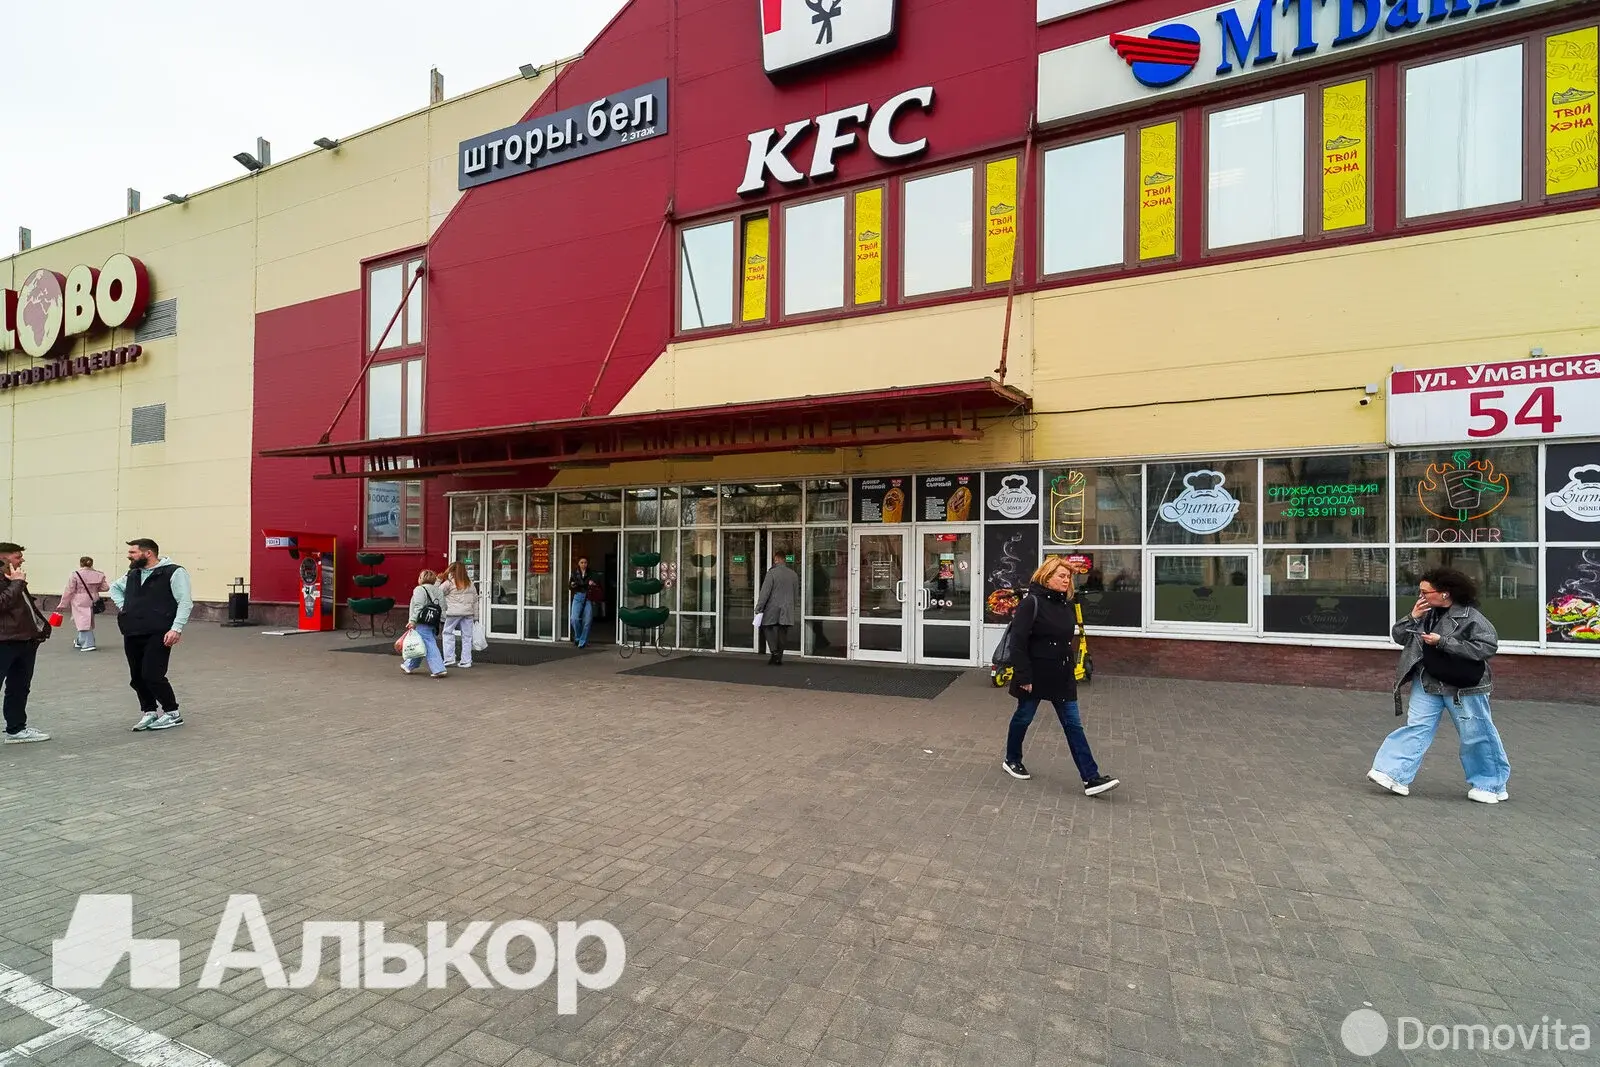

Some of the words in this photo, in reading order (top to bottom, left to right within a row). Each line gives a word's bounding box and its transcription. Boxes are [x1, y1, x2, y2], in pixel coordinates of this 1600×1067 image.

[1553, 102, 1591, 119] ТВОЙ
[1550, 117, 1594, 133] ХЭНД
[464, 94, 653, 174] шторы.бел
[621, 132, 628, 142] 2
[629, 125, 656, 140] этаж
[736, 86, 934, 195] KFC
[1326, 150, 1358, 164] ТВОЙ
[1324, 162, 1360, 175] ХЭНД
[1145, 184, 1171, 197] ТВОЙ
[1143, 197, 1172, 208] ХЭНД
[990, 215, 1013, 226] ТВОЙ
[74, 344, 141, 374] ЦЕНТР
[1415, 371, 1457, 392] ул.
[1465, 358, 1600, 384] Уманска
[1467, 386, 1562, 438] 54
[1268, 486, 1315, 496] СЛУЖБА
[1316, 483, 1379, 495] СПАСЕНИЯ
[991, 494, 1033, 507] Gurman
[1290, 497, 1306, 506] ОТ
[1307, 496, 1355, 506] ГОЛОДА
[1550, 490, 1600, 507] Gurm
[1163, 498, 1236, 519] Gurman
[1281, 508, 1305, 517] +375
[1307, 508, 1319, 517] 33
[1321, 507, 1336, 516] 911
[1340, 507, 1346, 516] 9
[1350, 507, 1365, 516] 911
[1426, 527, 1501, 542] DONER
